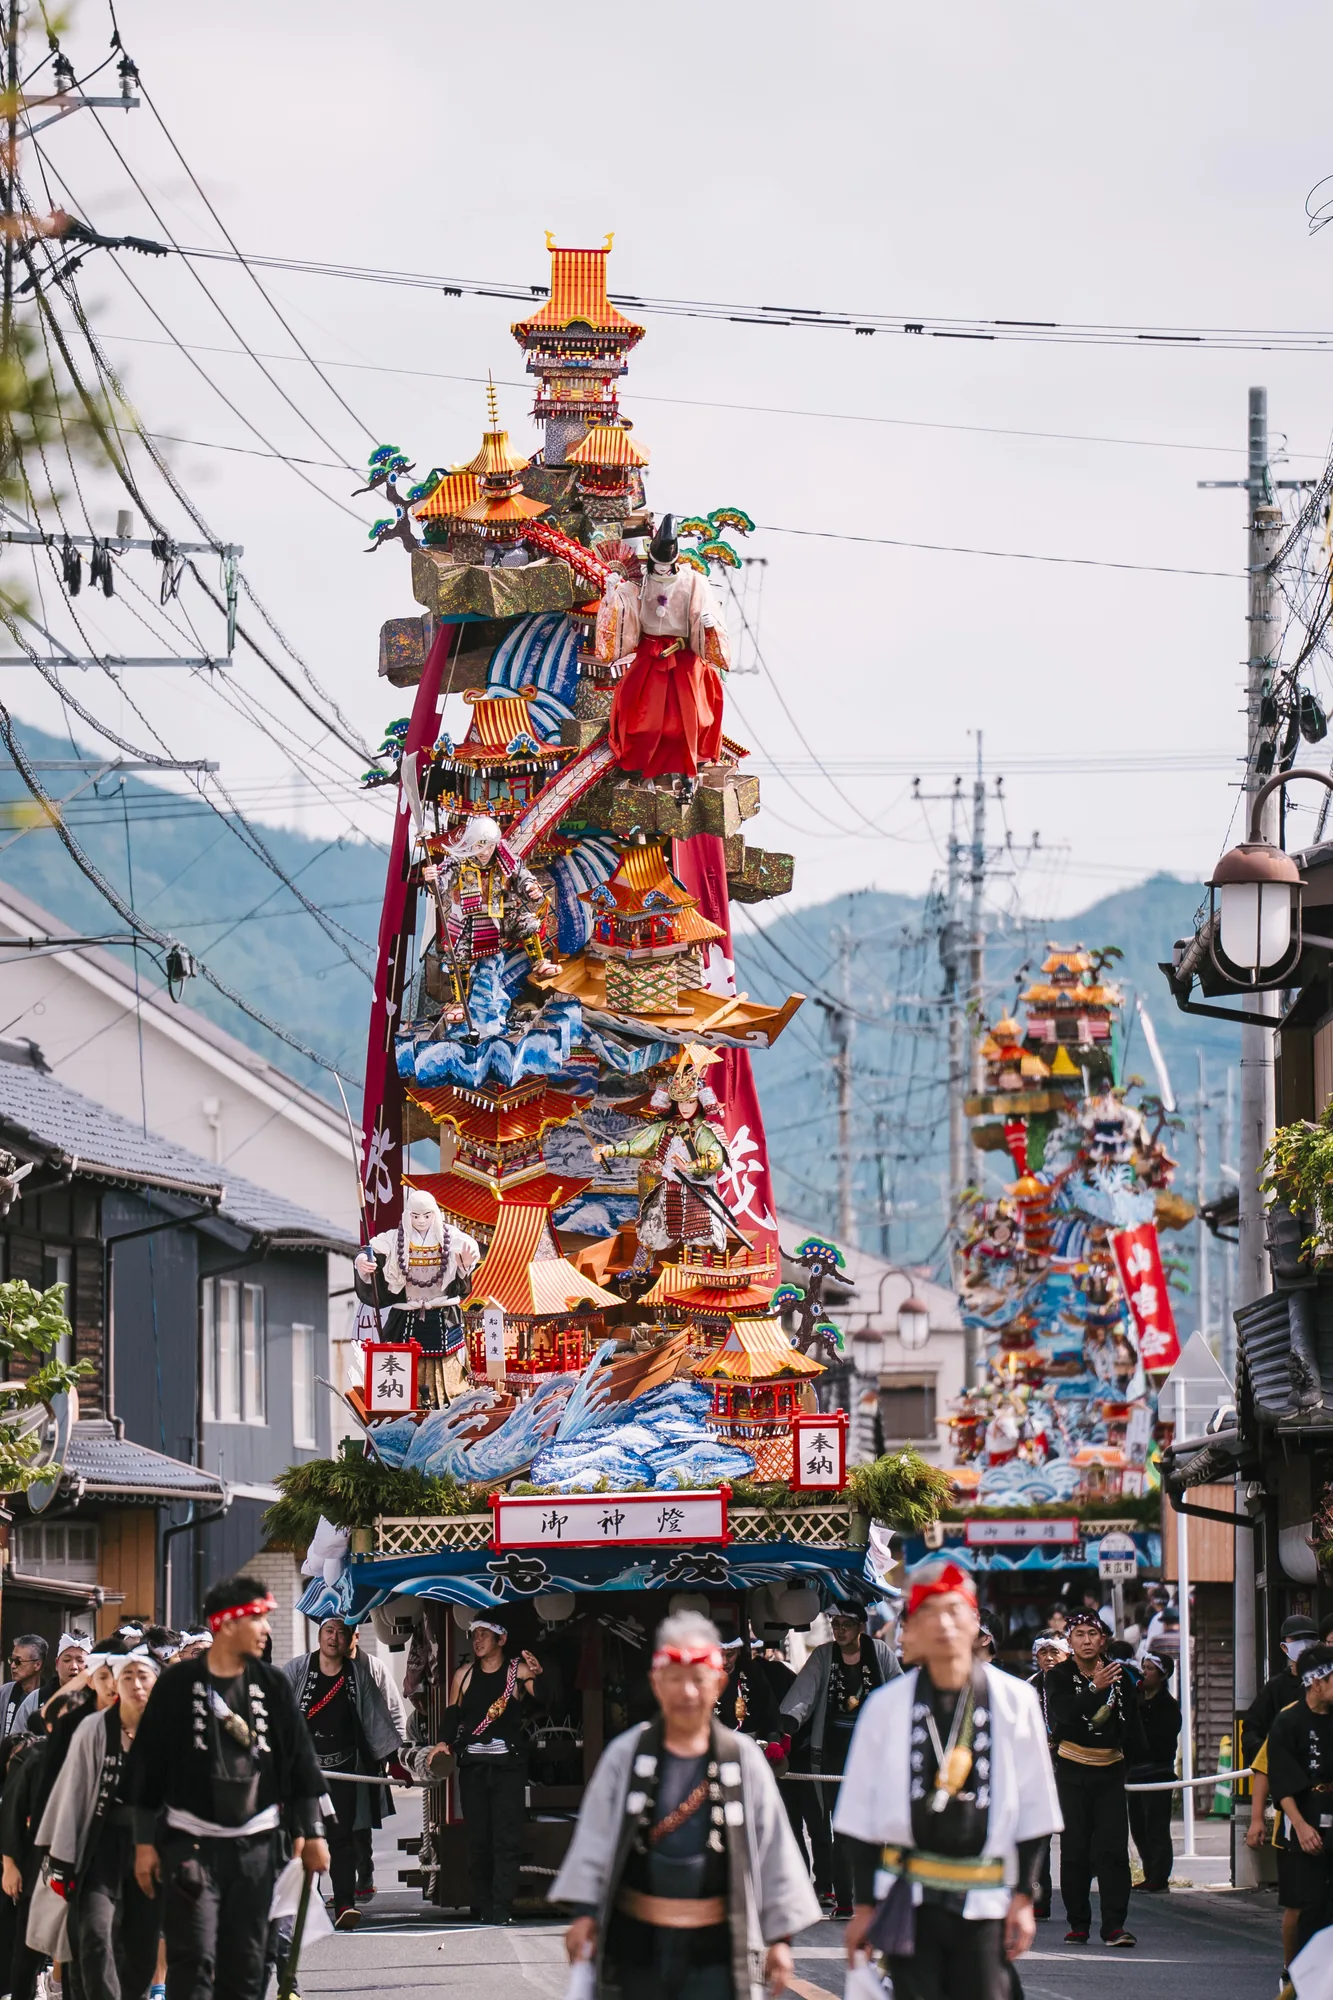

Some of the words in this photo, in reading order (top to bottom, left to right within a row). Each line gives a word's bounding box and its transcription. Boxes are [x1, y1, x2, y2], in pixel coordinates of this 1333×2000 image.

[488, 1317, 499, 1356] 船弁慶
[377, 1354, 406, 1399] 奉納
[806, 1432, 835, 1475] 奉納
[541, 1507, 685, 1539] 御神燈
[1102, 1561, 1133, 1574] 末広町
